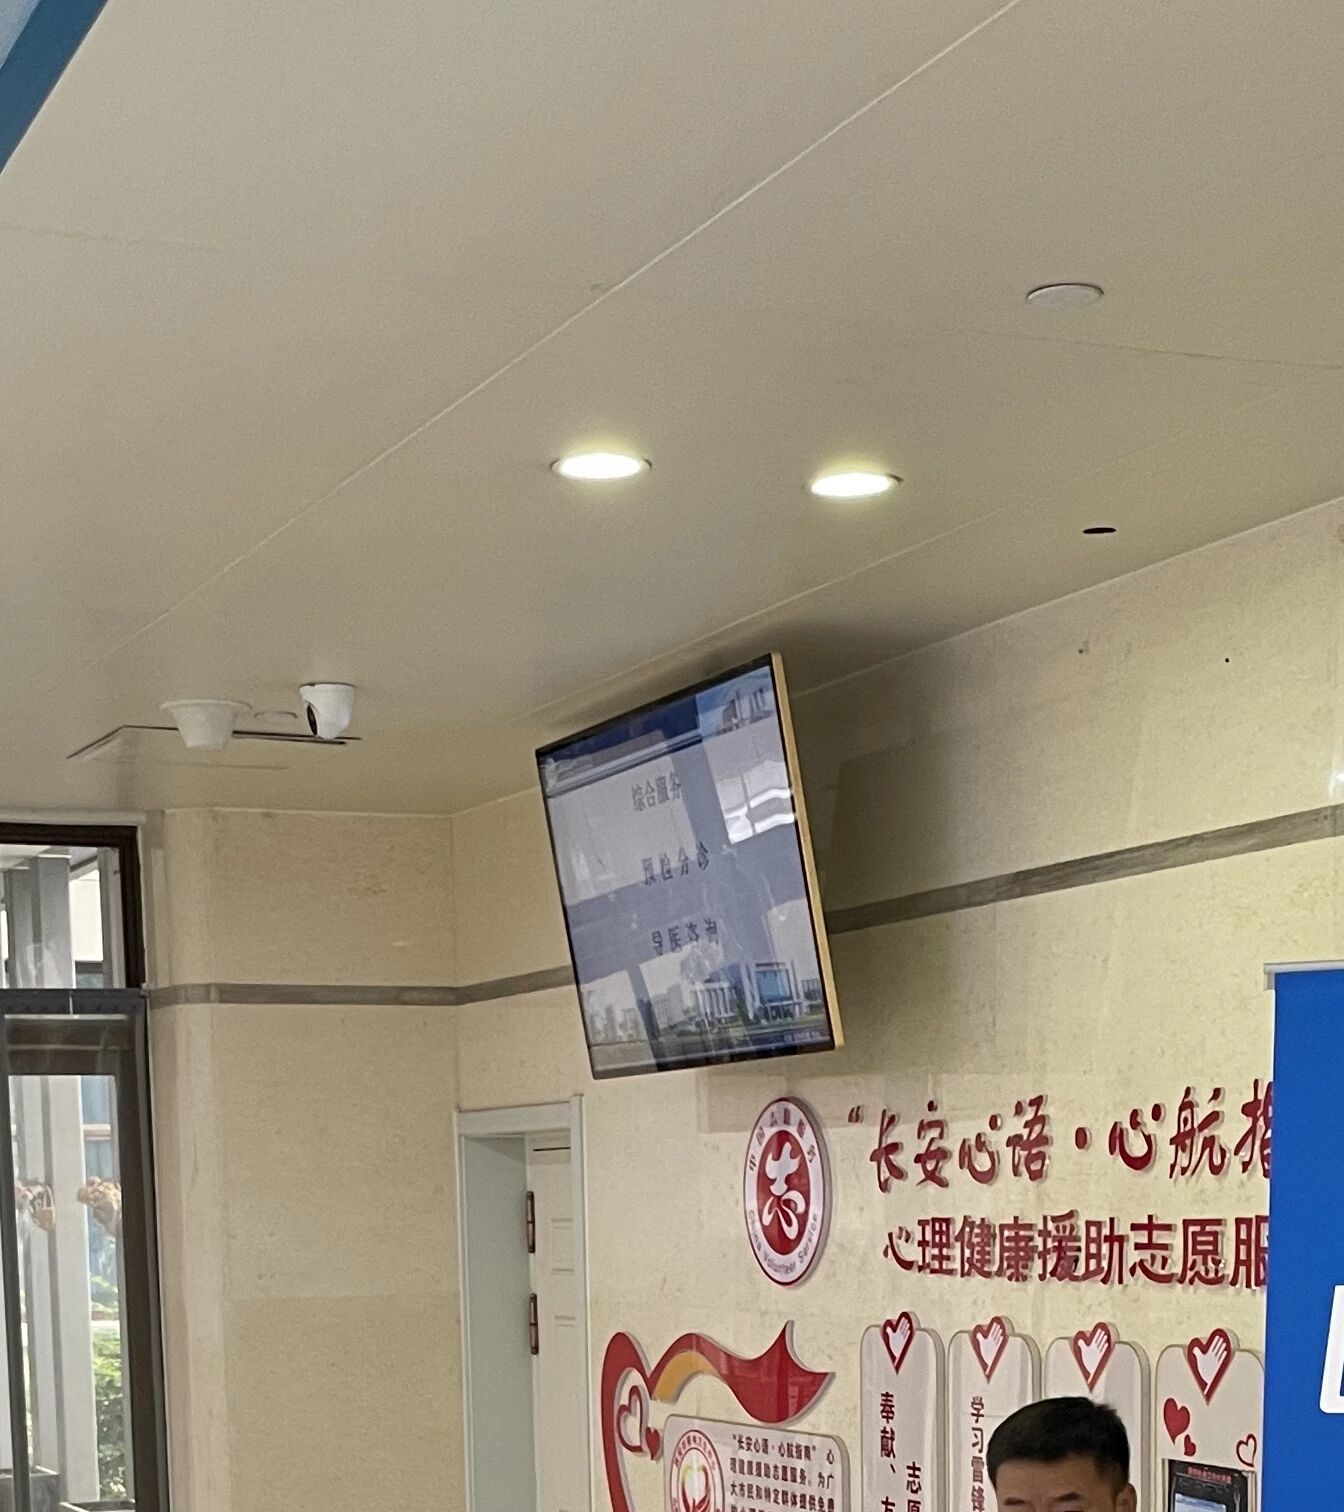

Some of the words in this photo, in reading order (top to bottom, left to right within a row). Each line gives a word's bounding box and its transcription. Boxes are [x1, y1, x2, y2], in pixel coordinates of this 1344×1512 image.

[883, 1209, 1269, 1289] 心理健康援助志愿服
